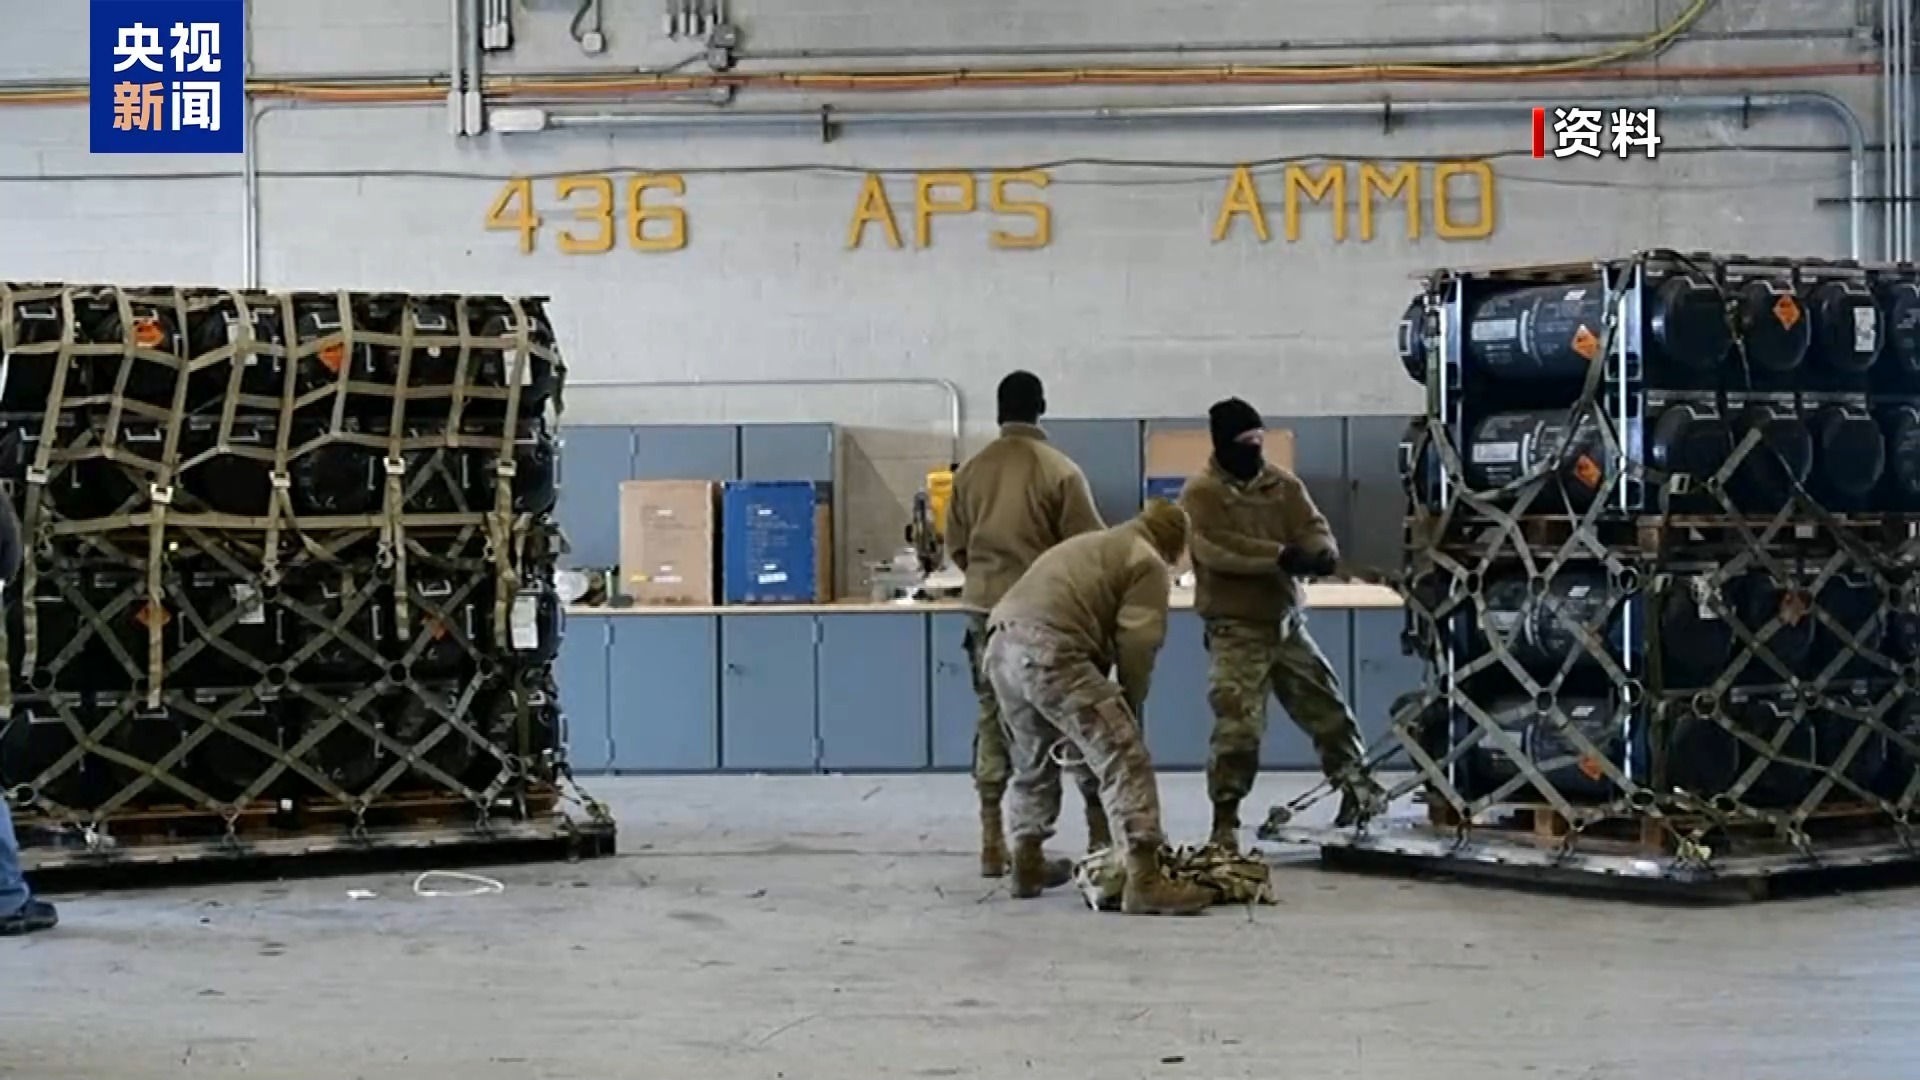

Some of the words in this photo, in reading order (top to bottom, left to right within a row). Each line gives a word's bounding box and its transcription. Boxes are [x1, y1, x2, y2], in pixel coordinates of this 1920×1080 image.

[484, 172, 692, 255] 436
[846, 169, 1054, 250] APS
[1210, 159, 1496, 242] AMMO
